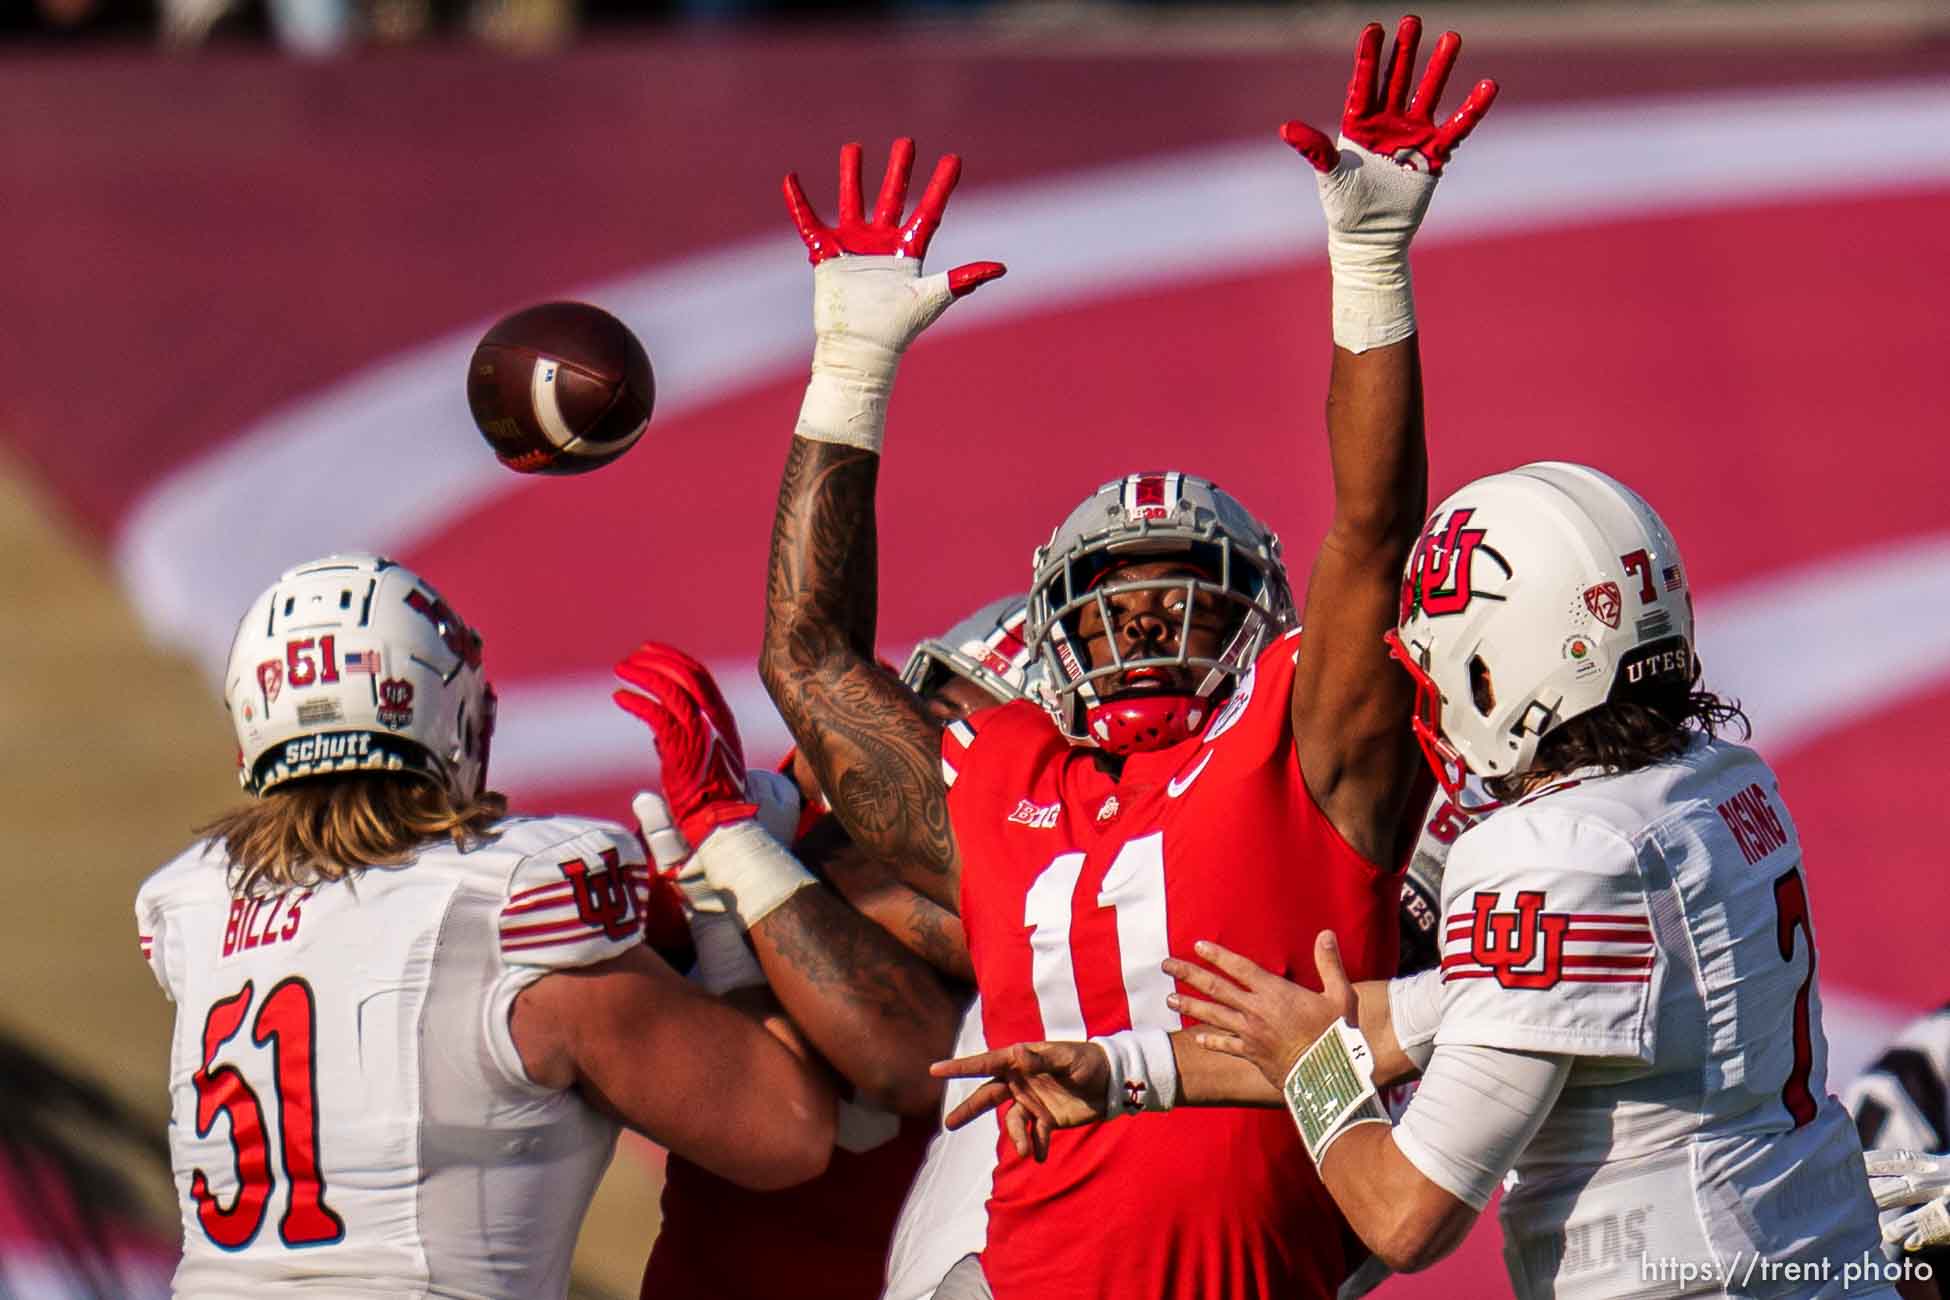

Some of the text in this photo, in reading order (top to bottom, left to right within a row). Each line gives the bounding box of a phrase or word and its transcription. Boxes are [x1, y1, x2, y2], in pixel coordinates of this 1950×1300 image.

[1620, 548, 1658, 605] 7
[286, 635, 340, 689] 51
[1626, 649, 1686, 684] UTES
[286, 732, 371, 764] schutt
[1716, 783, 1787, 866] RISING
[223, 891, 314, 957] BILLS
[1401, 882, 1436, 931] TES
[1024, 831, 1183, 1042] 11
[191, 976, 346, 1252] 51
